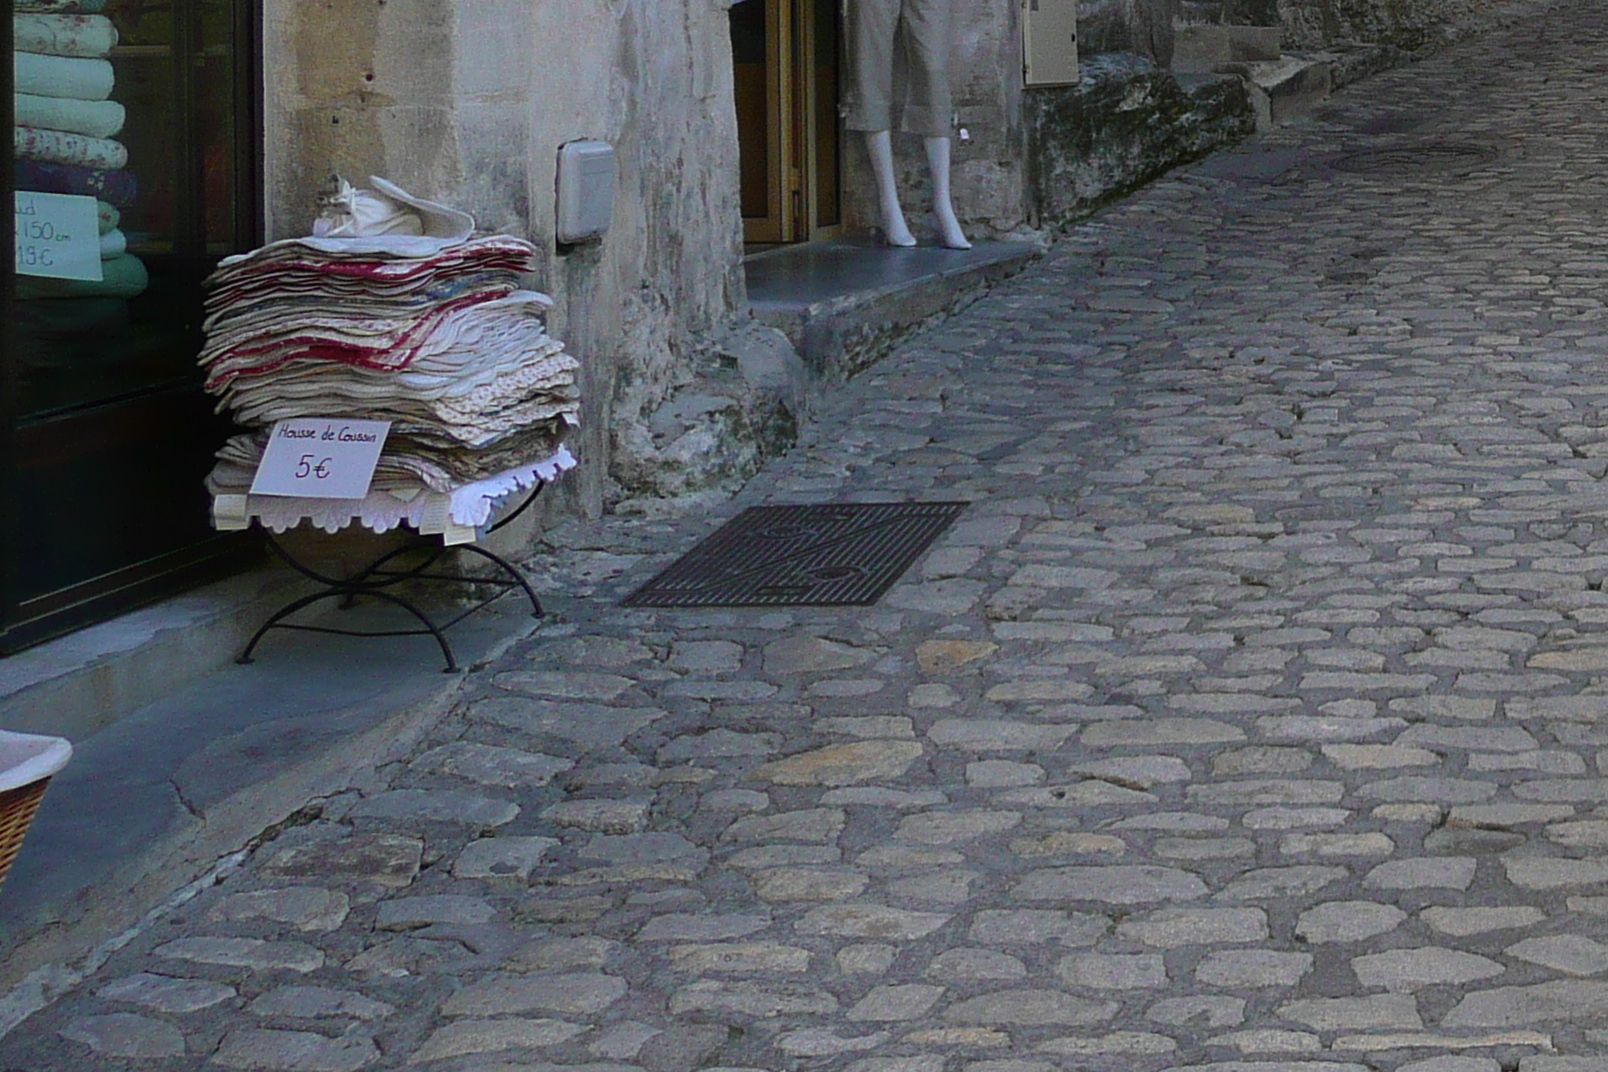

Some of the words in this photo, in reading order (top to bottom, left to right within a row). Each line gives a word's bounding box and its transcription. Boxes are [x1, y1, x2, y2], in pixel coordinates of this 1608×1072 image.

[23, 220, 54, 241] 150
[277, 422, 317, 439] Housse
[321, 424, 335, 441] de
[338, 426, 377, 443] Coussin
[295, 453, 333, 479] 5€
